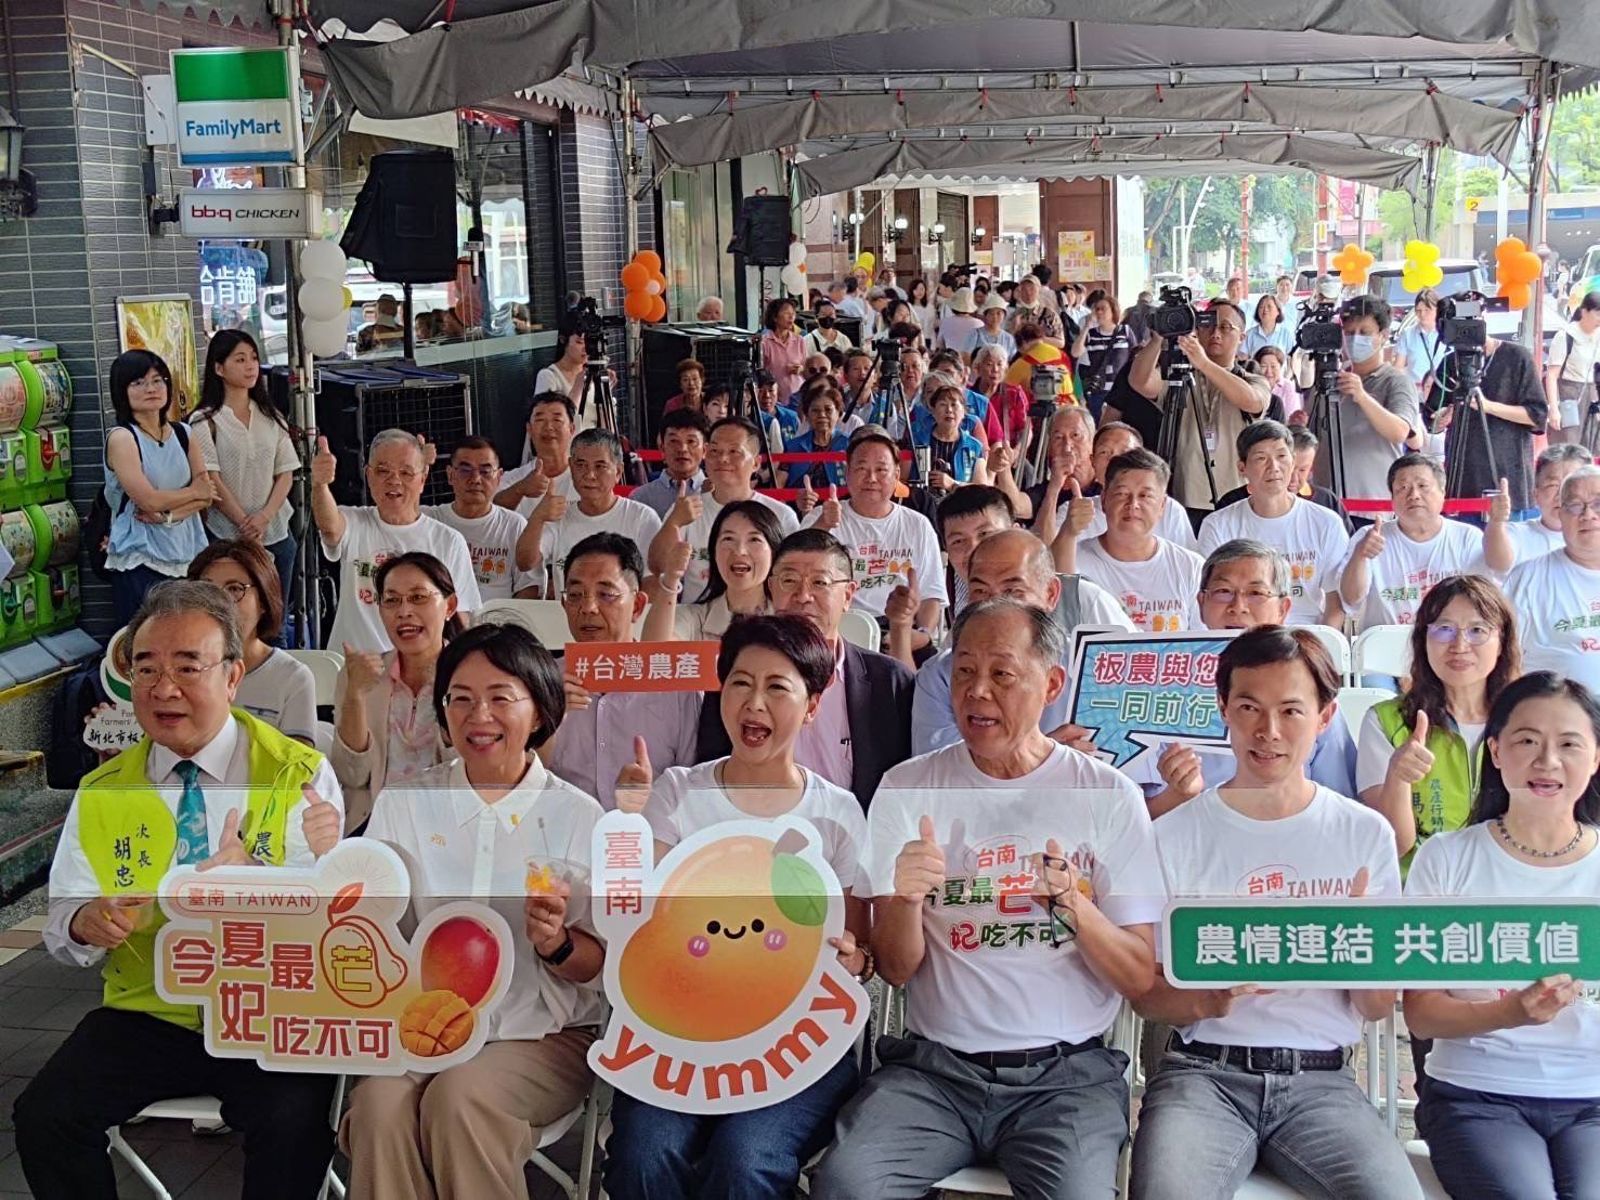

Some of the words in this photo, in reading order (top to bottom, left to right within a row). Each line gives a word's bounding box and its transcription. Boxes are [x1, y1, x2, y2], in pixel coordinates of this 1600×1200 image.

[185, 119, 281, 139] FamilyMart
[235, 209, 300, 219] CHICKEN
[1469, 201, 1479, 211] 2
[473, 547, 509, 557] TAIWAN
[879, 549, 913, 559] TAIWAN
[1281, 549, 1316, 561] AIWAN
[850, 558, 886, 575] 最芒
[856, 574, 897, 590] 吃不可
[1139, 599, 1183, 612] TAIWAN
[575, 653, 701, 681] #台灣農產
[1094, 652, 1218, 686] 板農與您
[1091, 691, 1217, 727] 一同前行
[88, 728, 145, 745] 新北市板
[977, 844, 1016, 868] 台南
[604, 831, 643, 916] 臺南
[1248, 872, 1283, 895] 台南
[187, 887, 225, 907] 臺南
[234, 891, 312, 907] TAIWAN
[1195, 923, 1374, 965] 農情連結
[1394, 921, 1580, 964] 共創價值
[219, 982, 393, 1059] 妃吃不可
[598, 971, 857, 1100] yummy
